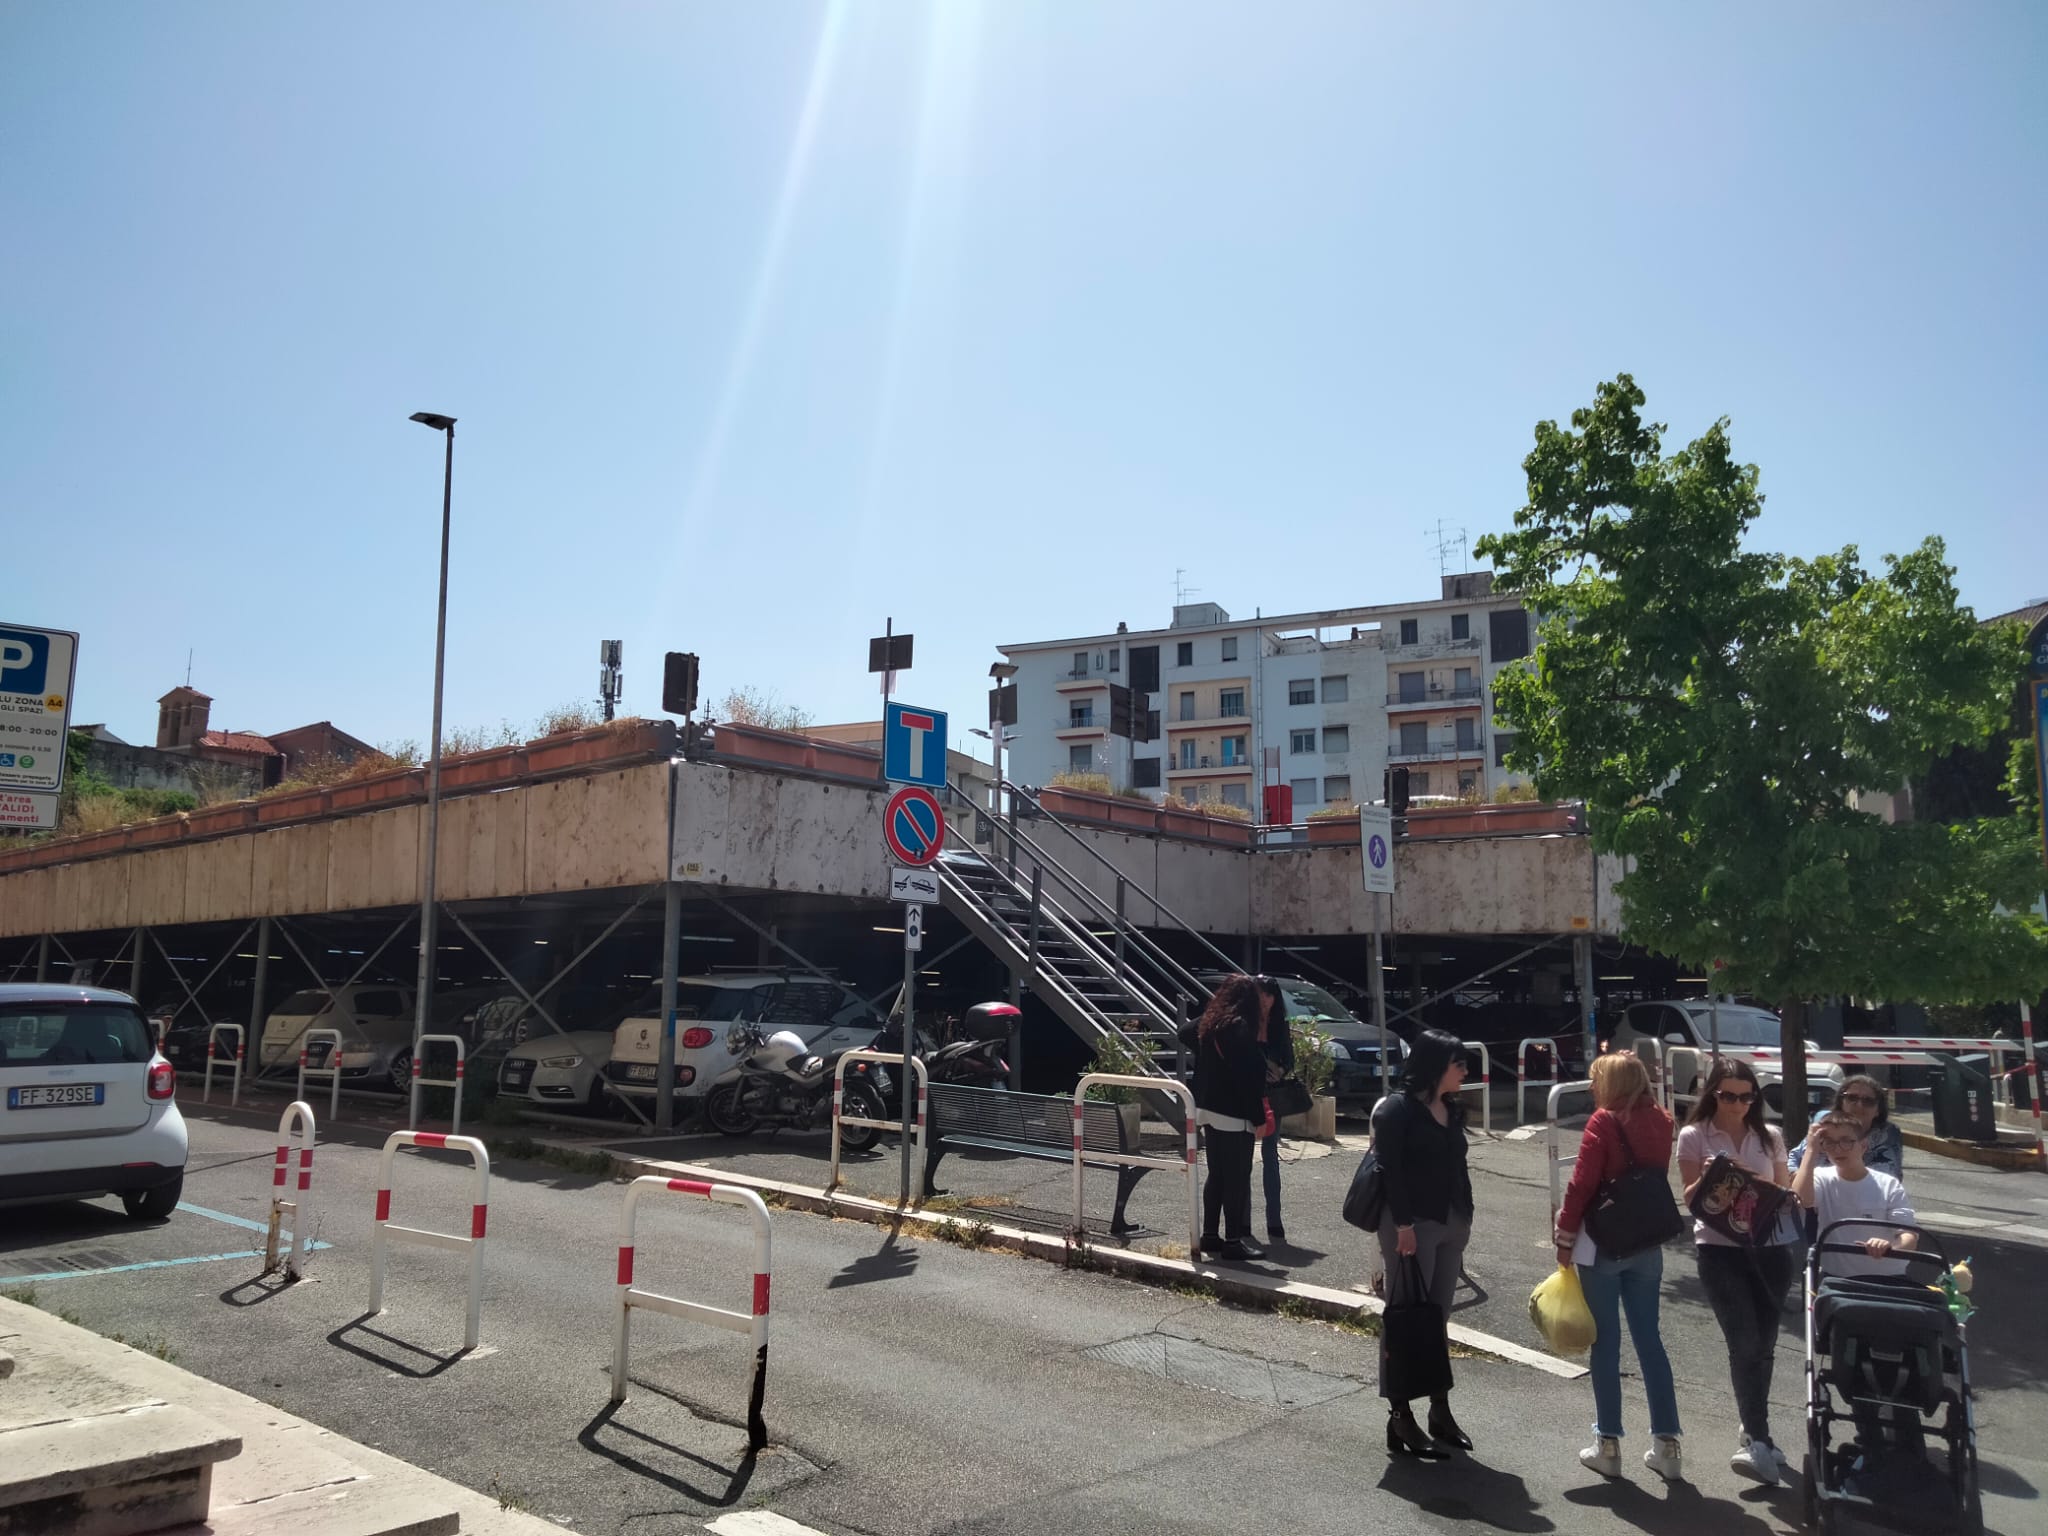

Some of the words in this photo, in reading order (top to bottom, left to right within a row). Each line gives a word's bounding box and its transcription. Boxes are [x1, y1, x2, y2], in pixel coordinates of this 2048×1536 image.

[0, 638, 33, 684] P
[15, 697, 44, 706] ZONA
[48, 699, 63, 707] A4
[18, 706, 43, 714] SPAZI
